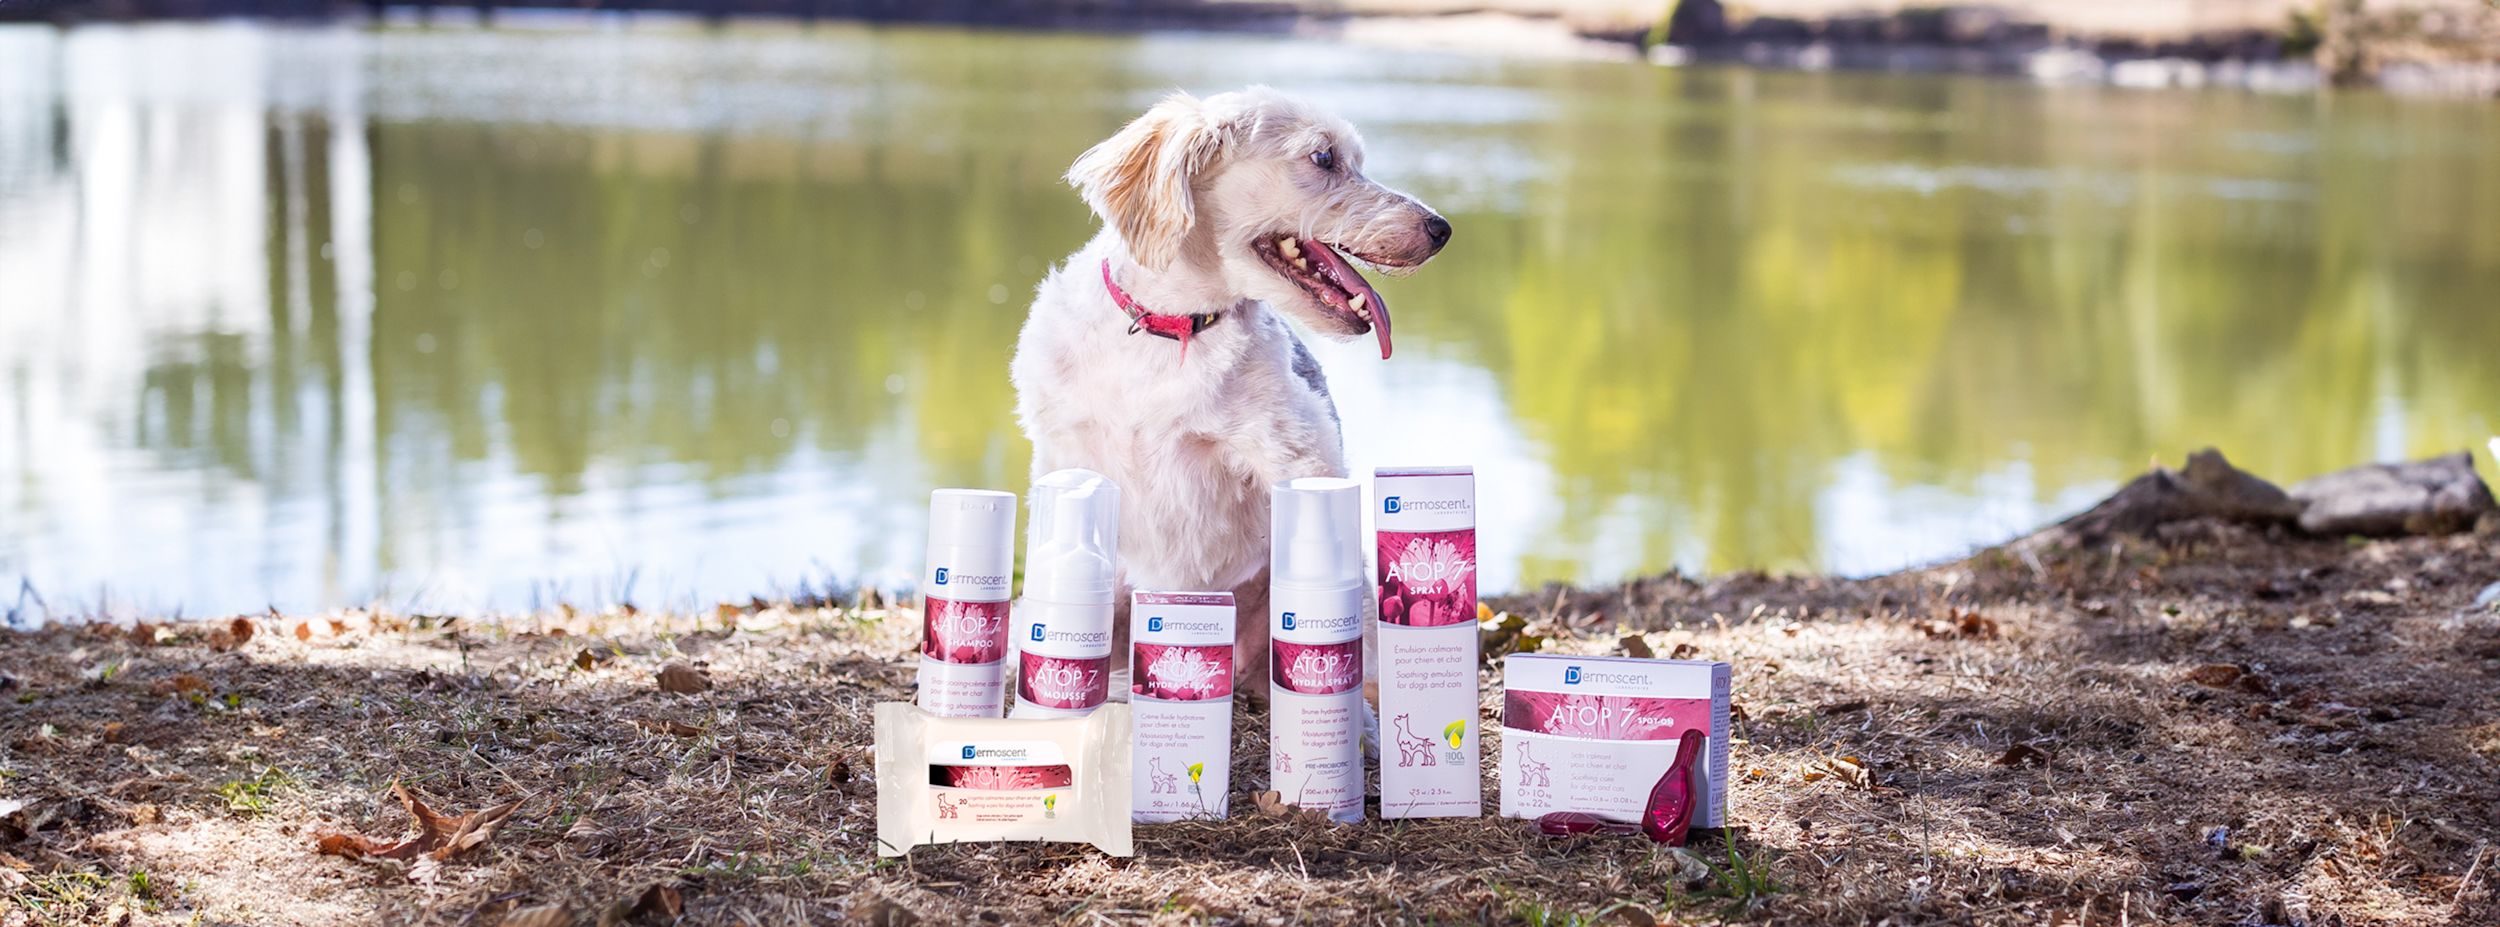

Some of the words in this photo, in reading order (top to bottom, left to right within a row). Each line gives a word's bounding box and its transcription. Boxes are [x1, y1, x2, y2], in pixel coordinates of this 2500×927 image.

[1385, 561, 1445, 583] ATOP
[1453, 560, 1468, 581] 7
[1410, 586, 1442, 595] SPRAY
[940, 616, 988, 635] ATOP
[991, 616, 1001, 633] 7
[947, 638, 994, 649] SHAMPOO
[1428, 644, 1462, 653] calmante
[1292, 655, 1338, 674] ATOP
[1343, 653, 1353, 672] 7
[1395, 657, 1412, 666] pour
[1414, 655, 1435, 664] chien
[1436, 655, 1444, 664] et
[1445, 654, 1462, 663] chat
[1147, 660, 1198, 677] ATOP
[1207, 661, 1220, 677] 7
[1395, 669, 1428, 680] Soothing
[1430, 669, 1463, 678] emulsion
[1035, 668, 1083, 688] ATOP
[1088, 669, 1098, 687] 7
[1292, 678, 1324, 687] HYDRA
[1327, 676, 1353, 686] SPRAY
[1564, 666, 1649, 685] Dermoscent
[1148, 681, 1179, 689] HYDRA
[1183, 682, 1214, 690] CREAM
[1396, 680, 1407, 689] for
[1408, 681, 1428, 691] dogs
[1430, 680, 1446, 689] and
[1446, 680, 1462, 689] cats
[1044, 690, 1086, 701] MOUSSE
[1549, 703, 1612, 727] ATOP
[1620, 708, 1636, 728] 7
[962, 745, 1026, 759] Dermoscent
[960, 769, 1003, 786] ATOP
[1581, 783, 1597, 793] dogs
[1597, 784, 1611, 792] and
